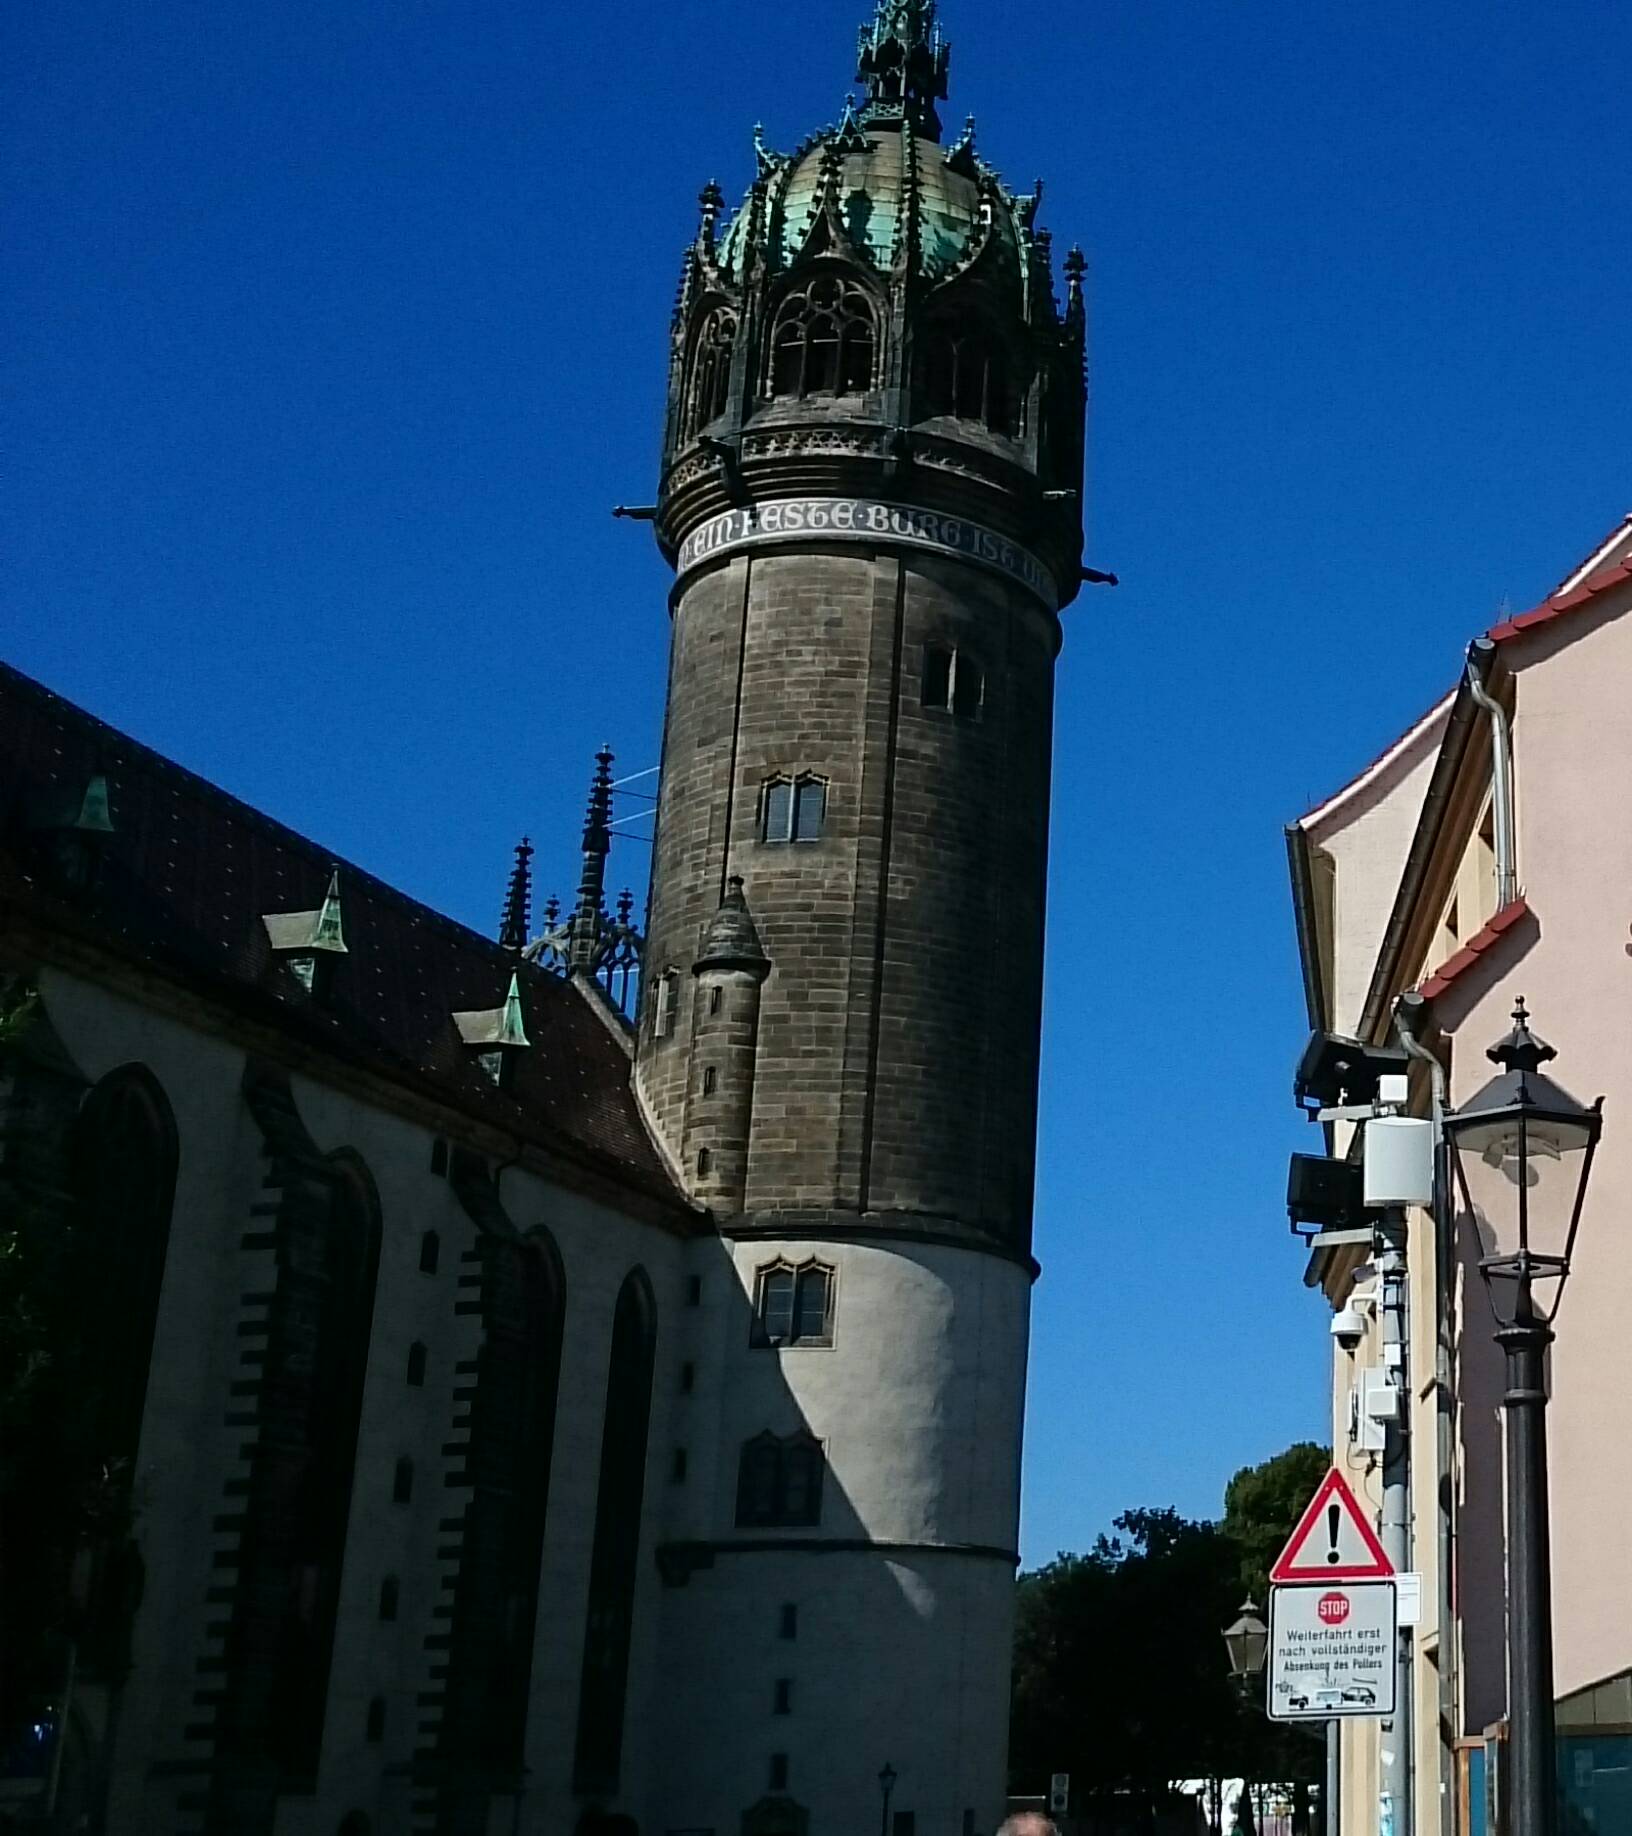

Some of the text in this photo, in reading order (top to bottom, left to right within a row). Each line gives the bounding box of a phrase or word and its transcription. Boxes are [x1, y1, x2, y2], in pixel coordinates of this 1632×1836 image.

[740, 502, 857, 538] FESTE
[866, 504, 960, 546] BURG
[1319, 1600, 1348, 1616] STOP
[1287, 1628, 1380, 1642] Weiterfahrt erst
[1279, 1643, 1387, 1657] nach vollständiger
[1283, 1658, 1383, 1673] Absenkung des Pollers
